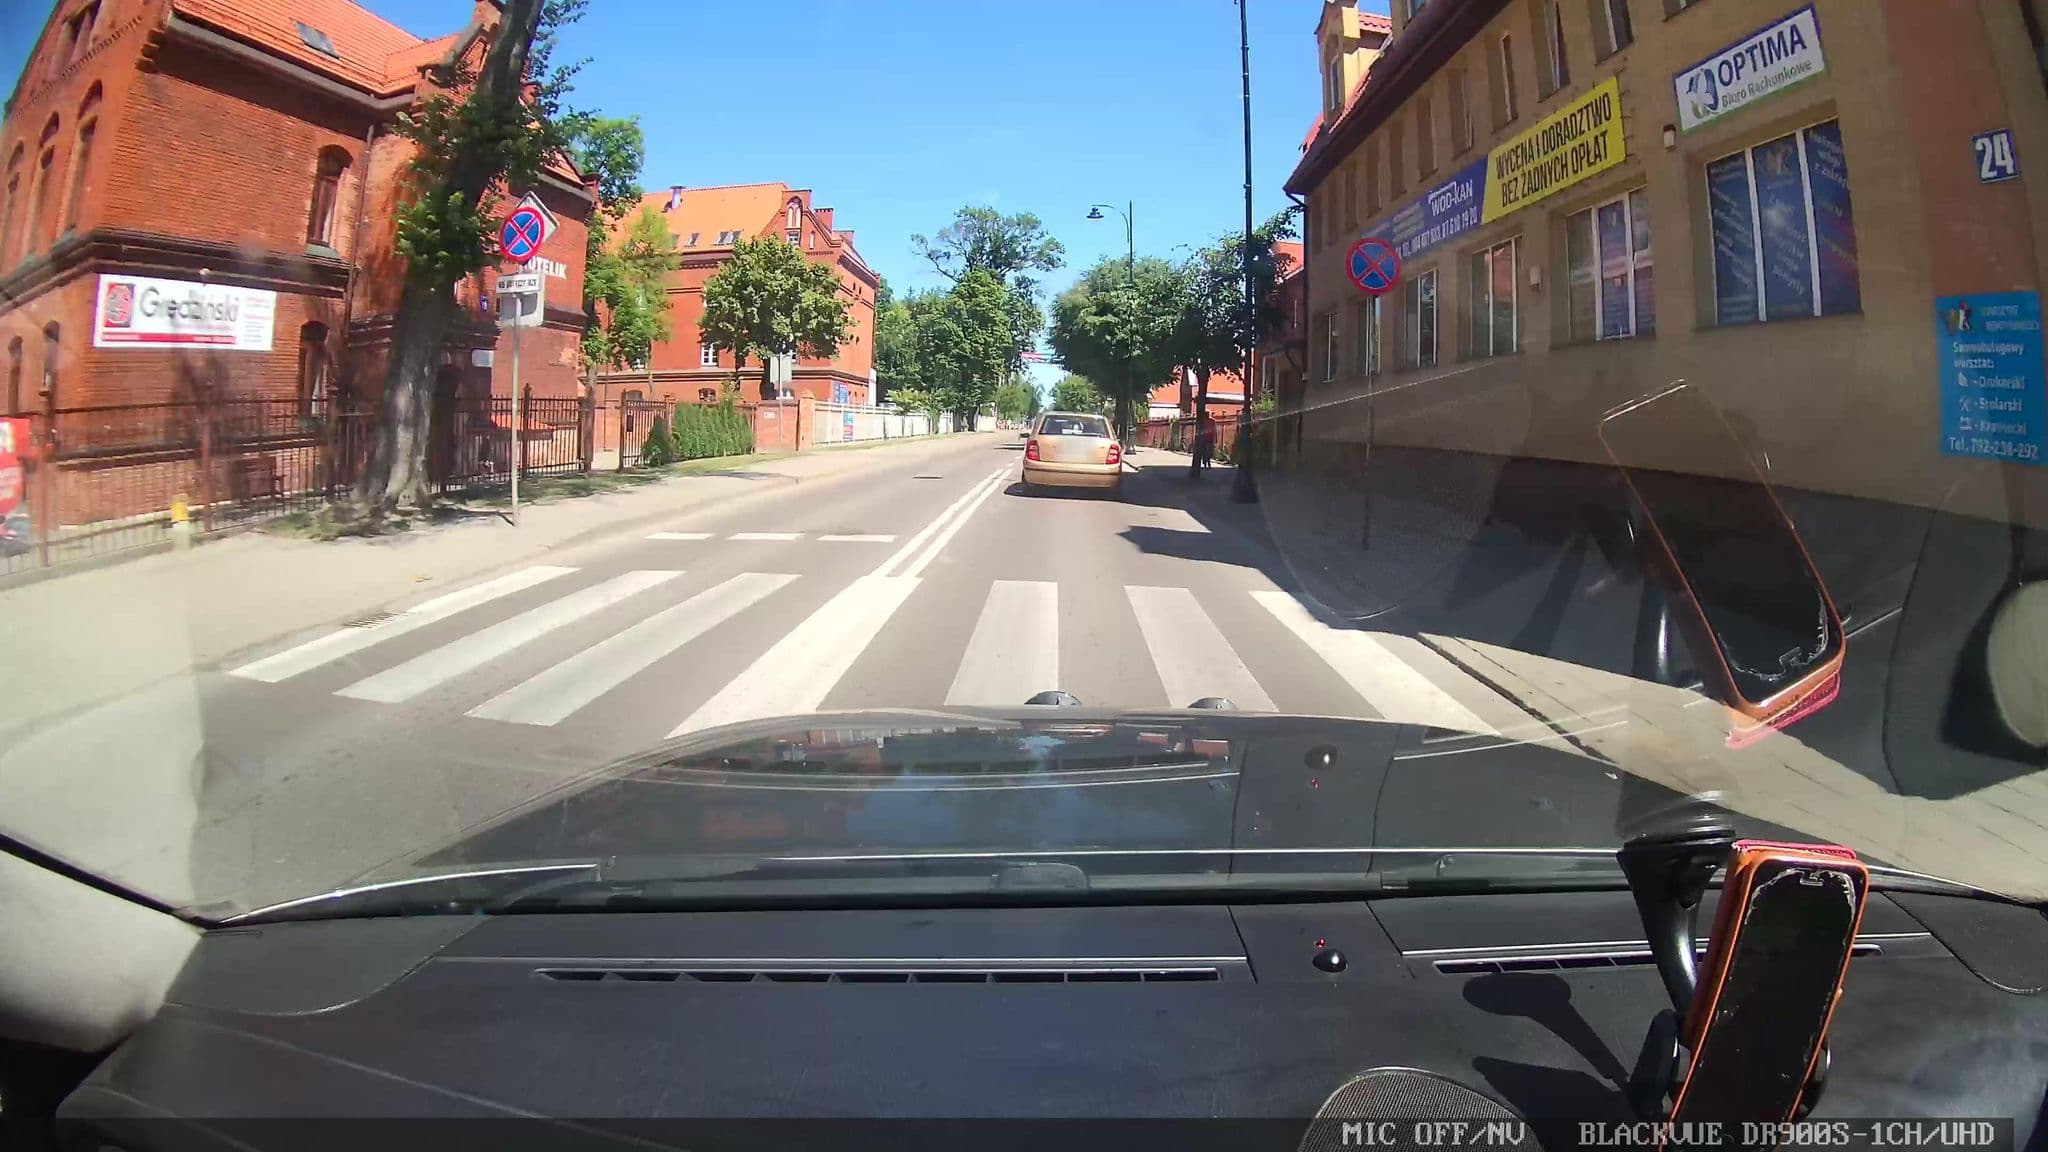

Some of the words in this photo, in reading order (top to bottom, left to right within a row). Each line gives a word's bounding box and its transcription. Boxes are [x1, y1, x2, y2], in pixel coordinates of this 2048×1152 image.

[1718, 24, 1807, 87] OPTIMA
[1722, 89, 1747, 108] Biuro
[1748, 60, 1812, 96] Rachunkowe
[1496, 138, 1535, 180] WYCENA
[1536, 133, 1541, 159] I
[1541, 92, 1612, 156] DORADZTWO
[1975, 132, 2014, 179] 24
[1502, 177, 1520, 208] BEZ
[1521, 150, 1569, 199] ŻADNYCH
[1570, 129, 1608, 175] OPŁAT
[1431, 179, 1473, 217] WOD-KAN
[519, 255, 567, 279] OTELIK
